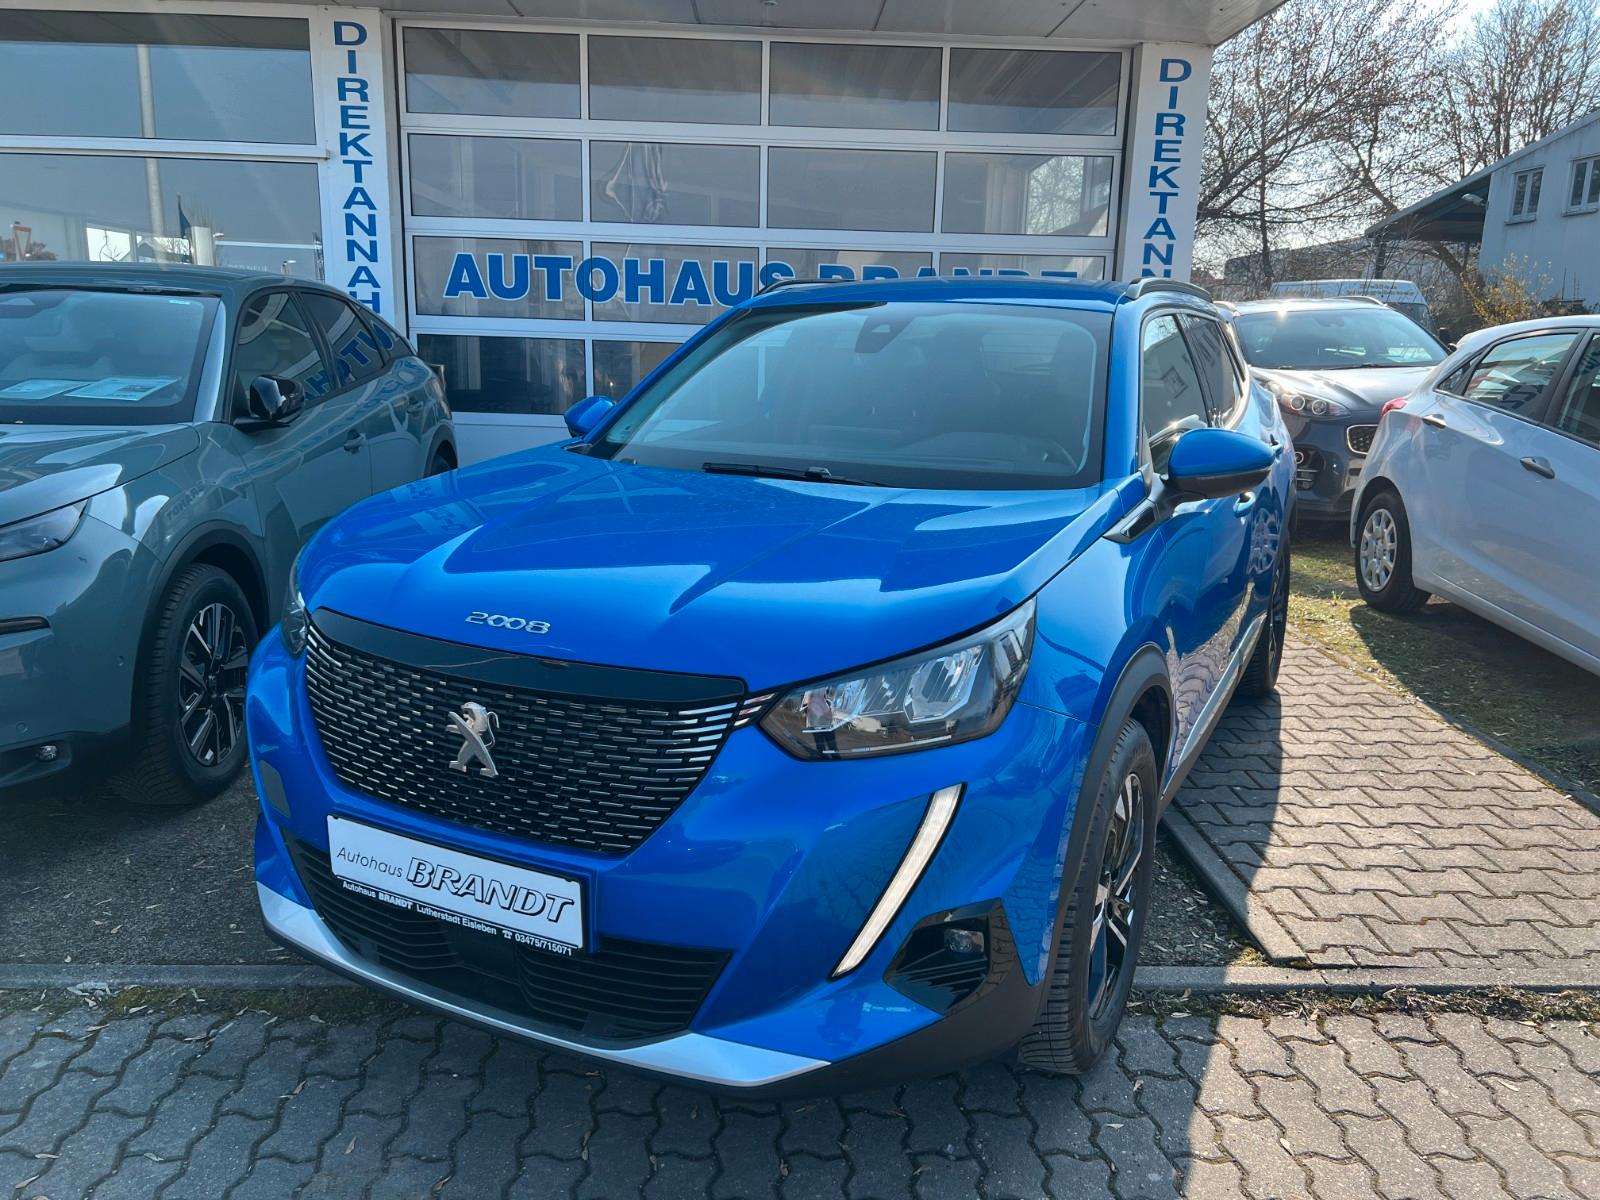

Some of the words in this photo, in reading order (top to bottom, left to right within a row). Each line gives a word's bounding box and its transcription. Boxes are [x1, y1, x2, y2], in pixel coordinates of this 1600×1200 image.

[465, 611, 551, 634] 2008
[336, 847, 403, 878] Autohaus
[406, 857, 575, 923] BRANDT
[342, 880, 376, 898] Autohaus
[378, 892, 413, 910] BRANDT
[416, 904, 461, 925] Lutherstadt
[462, 918, 497, 935] Eisleben
[514, 933, 572, 956] 03475/715071
